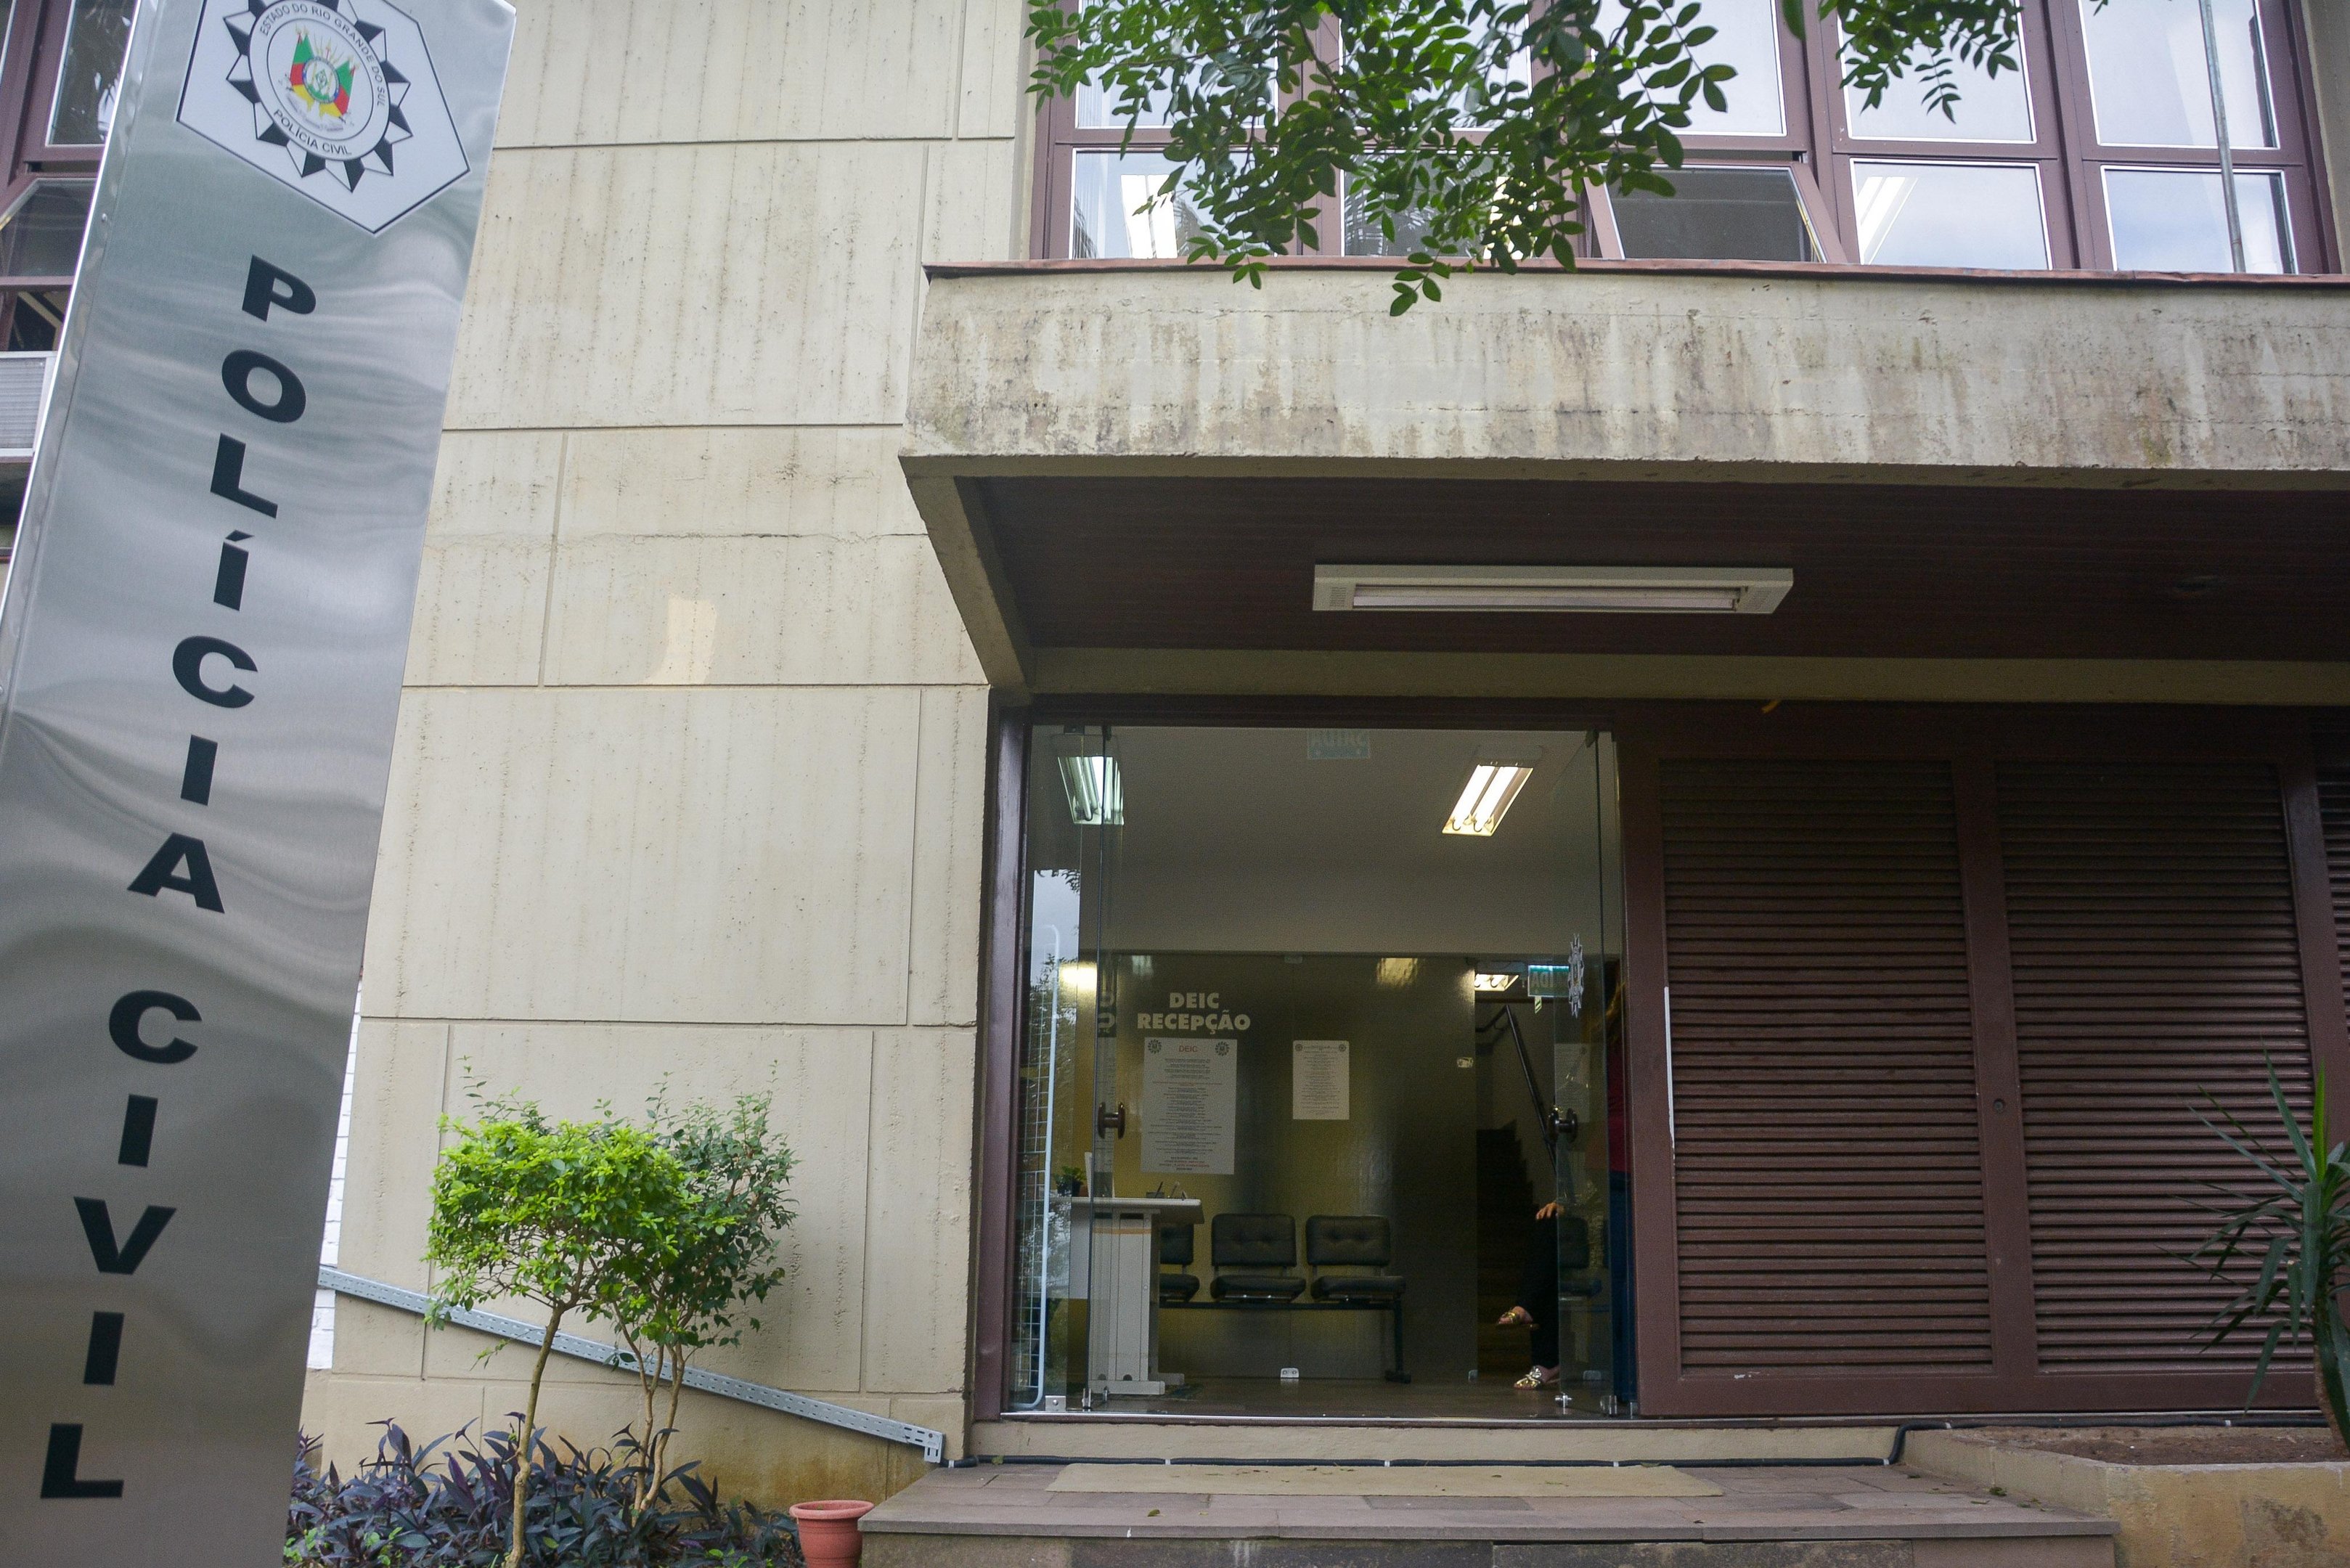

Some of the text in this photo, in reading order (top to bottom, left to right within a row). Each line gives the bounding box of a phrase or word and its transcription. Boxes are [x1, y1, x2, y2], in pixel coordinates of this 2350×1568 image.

[260, 3, 385, 107] ESTADO DO RIO GRANDE DO SUL
[322, 142, 352, 155] CIVIL
[41, 255, 317, 1499] POLÍCIA CIVIL
[1170, 992, 1220, 1008] DEIC
[1137, 1010, 1251, 1034] RECEPÇÃO
